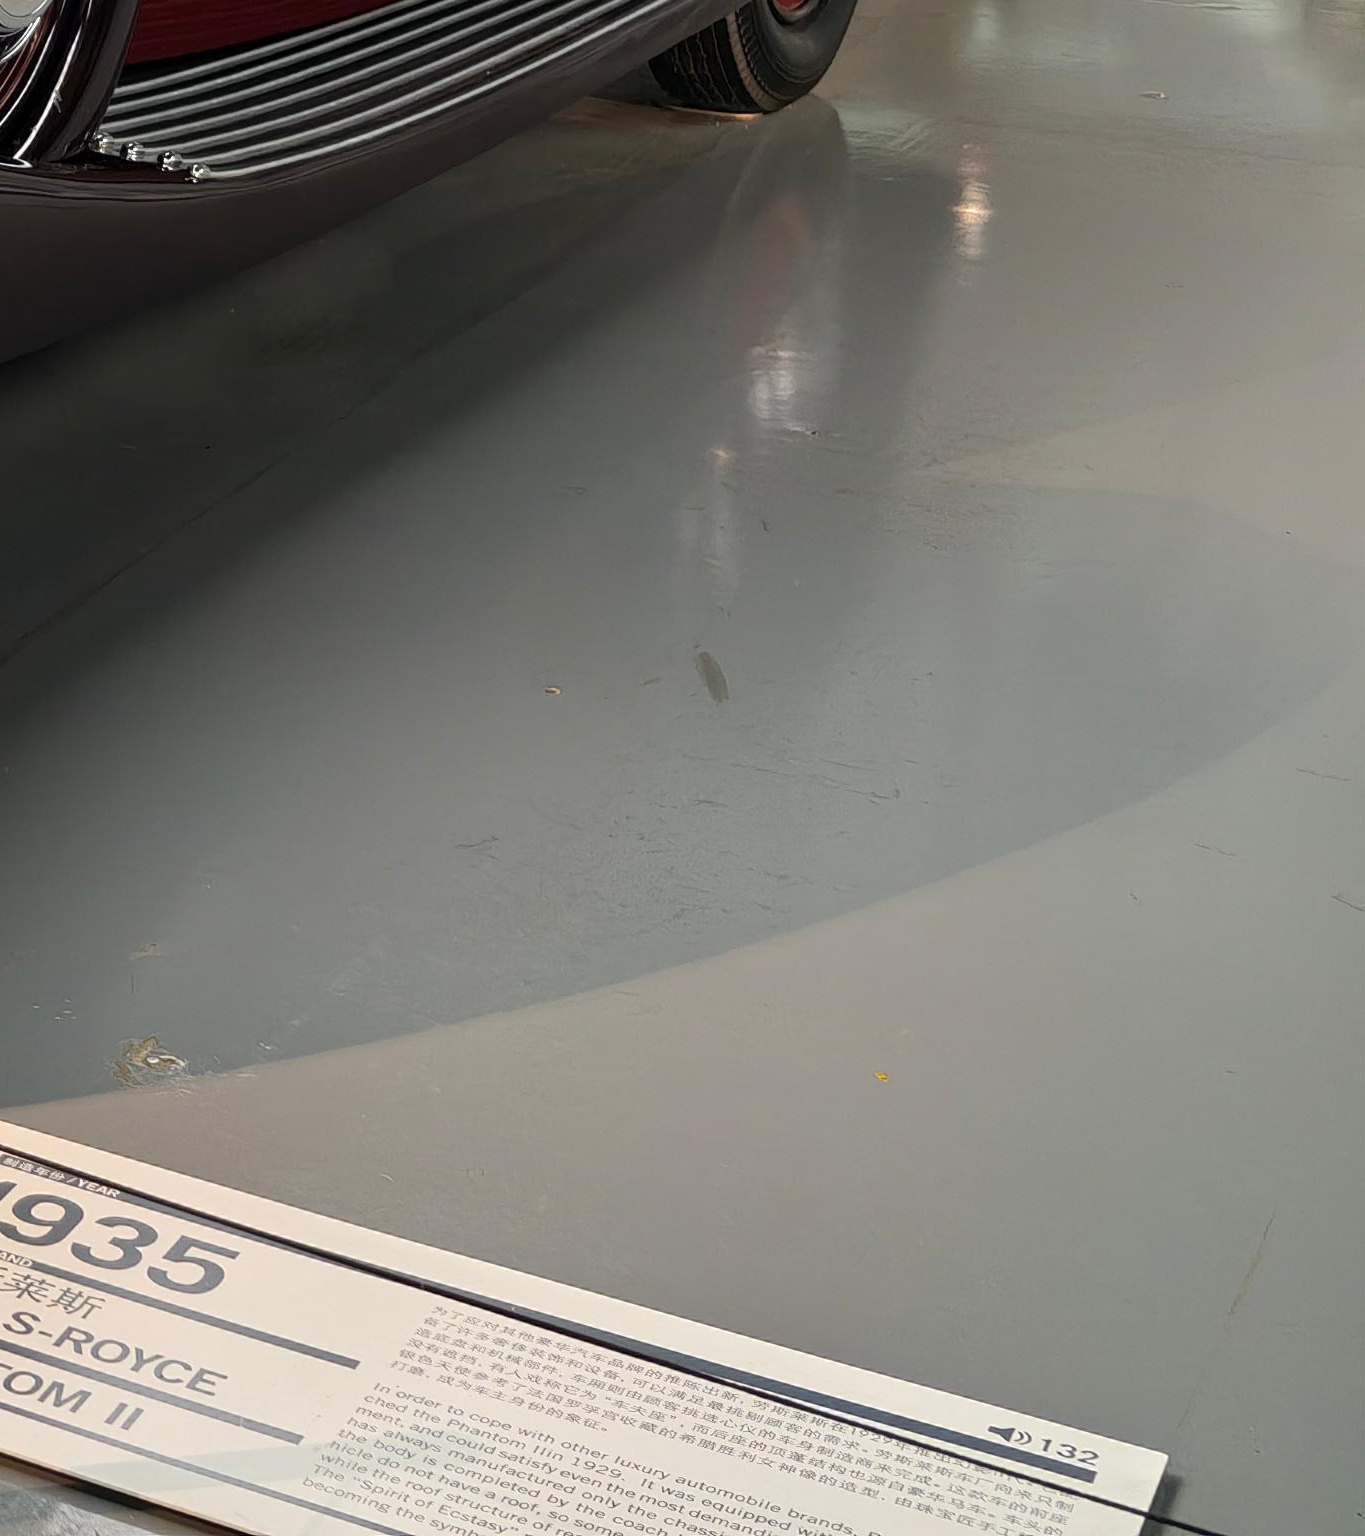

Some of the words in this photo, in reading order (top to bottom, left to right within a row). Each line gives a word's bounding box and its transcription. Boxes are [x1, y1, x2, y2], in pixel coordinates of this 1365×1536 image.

[103, 1402, 145, 1432] II
[373, 1382, 390, 1394] In
[396, 1389, 442, 1409] order
[447, 1404, 464, 1416] to
[469, 1413, 512, 1430] cope
[518, 1426, 555, 1444] with
[560, 1441, 609, 1460] other
[614, 1455, 671, 1479] luxury
[675, 1476, 782, 1513] automobile
[1041, 1437, 1100, 1466] 132
[302, 1477, 392, 1514] becoming
[396, 1507, 425, 1523] the
[313, 1464, 345, 1482] The
[414, 1497, 434, 1509] of
[320, 1453, 368, 1473] while
[372, 1469, 401, 1484] the
[405, 1479, 443, 1497] roof
[445, 1492, 528, 1525] structure
[532, 1519, 554, 1533] of
[329, 1440, 373, 1460] hicle
[377, 1456, 400, 1469] do
[404, 1465, 434, 1481] not
[439, 1474, 481, 1494] have
[484, 1490, 496, 1499] a
[500, 1494, 540, 1515] roof,
[549, 1510, 569, 1522] so
[337, 1428, 367, 1444] the
[374, 1439, 417, 1460] body
[423, 1454, 437, 1465] is
[443, 1463, 540, 1498] completed
[547, 1493, 569, 1508] by
[575, 1503, 606, 1519] the
[347, 1417, 377, 1433] has
[383, 1427, 441, 1453] always
[448, 1448, 576, 1495] manufactured
[582, 1490, 620, 1509] only
[627, 1503, 657, 1520] the
[355, 1406, 404, 1427] ment,
[409, 1421, 444, 1439] and
[446, 1433, 496, 1455] could
[497, 1448, 557, 1474] satisfy
[560, 1469, 602, 1488] even
[607, 1482, 636, 1499] the
[639, 1494, 685, 1517] most
[689, 1509, 772, 1536] demand
[364, 1394, 408, 1413] ched
[413, 1408, 441, 1424] the
[447, 1419, 526, 1450] Phantom
[572, 1457, 626, 1481] 1929.
[640, 1478, 655, 1490] It
[661, 1486, 695, 1502] was
[701, 1497, 792, 1531] equipped
